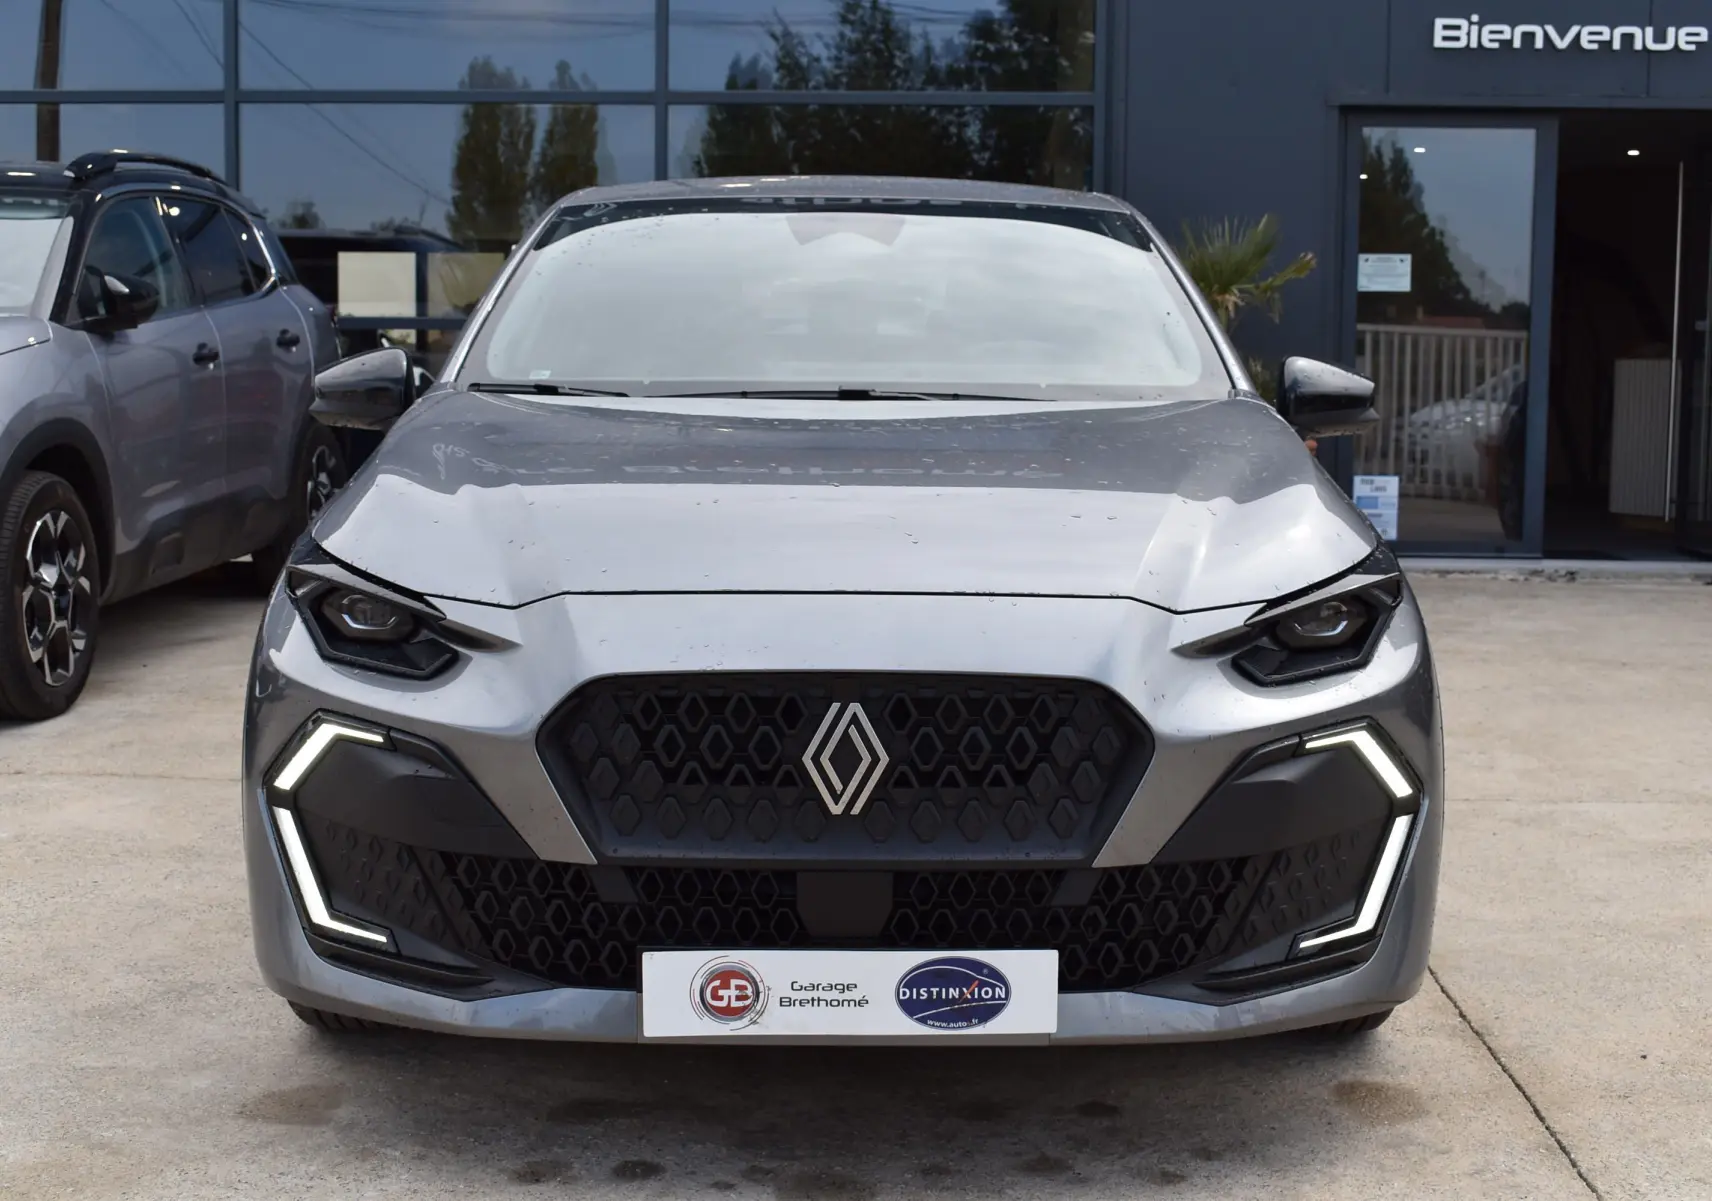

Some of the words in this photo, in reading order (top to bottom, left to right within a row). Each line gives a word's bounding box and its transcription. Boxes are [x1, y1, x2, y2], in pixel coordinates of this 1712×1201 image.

[1433, 13, 1709, 51] Bienvenue
[706, 978, 753, 1007] GB
[790, 981, 858, 994] Garage
[899, 982, 1006, 1002] DISTINXION
[779, 995, 870, 1008] Brethomé
